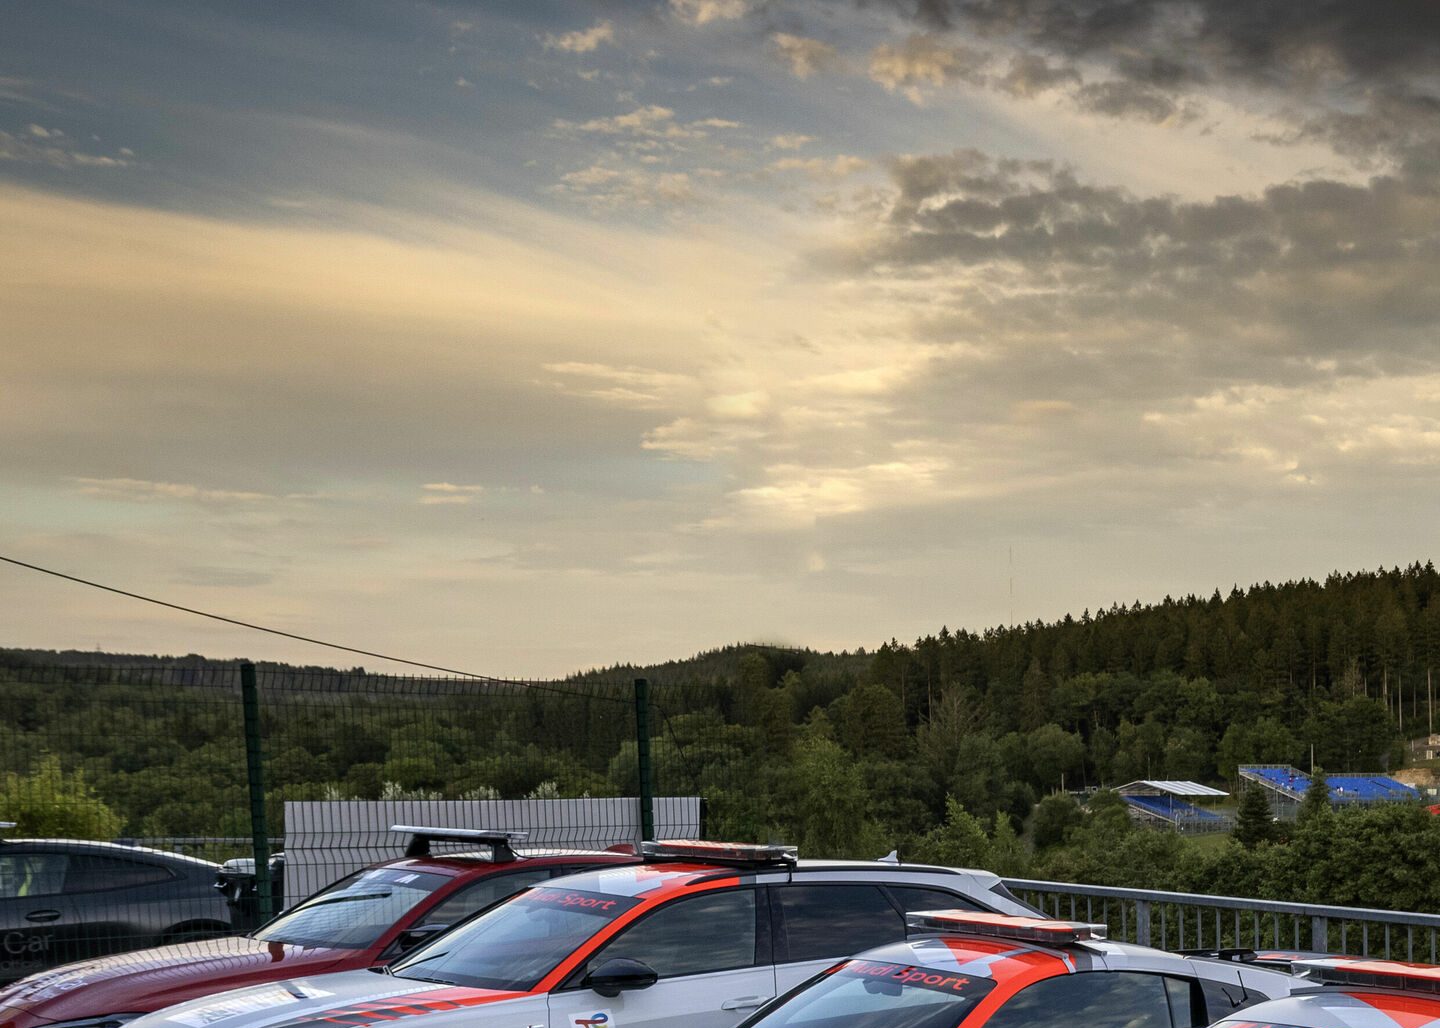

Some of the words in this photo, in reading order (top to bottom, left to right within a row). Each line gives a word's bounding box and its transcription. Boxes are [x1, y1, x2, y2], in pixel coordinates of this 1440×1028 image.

[558, 893, 616, 910] Sport
[4, 931, 53, 954] Car
[892, 966, 970, 990] Sport
